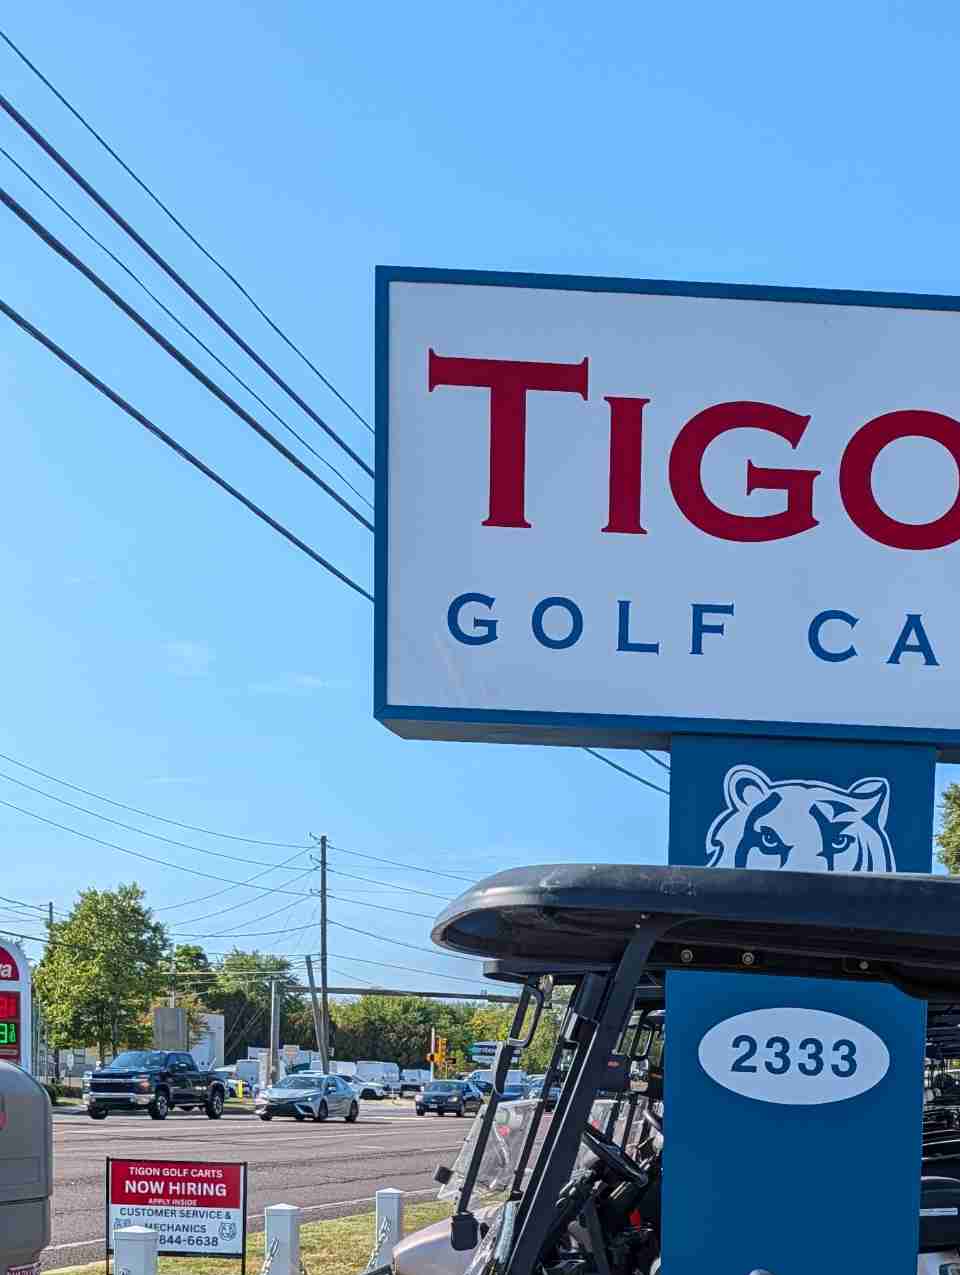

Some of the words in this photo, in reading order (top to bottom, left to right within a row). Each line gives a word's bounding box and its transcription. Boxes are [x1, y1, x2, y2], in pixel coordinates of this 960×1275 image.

[447, 592, 735, 656] GOLF
[731, 1035, 857, 1078] 2333
[128, 1166, 160, 1176] TIGON
[162, 1168, 189, 1177] GOLF
[190, 1169, 223, 1178] CARTS
[124, 1180, 164, 1194] NOW
[168, 1183, 227, 1197] HIRING
[148, 1198, 170, 1206] APPLY
[119, 1207, 180, 1218] CUSTOMER
[181, 1209, 224, 1220] SERVICE
[225, 1211, 232, 1220] &
[144, 1222, 207, 1234] MECHANICS
[159, 1235, 218, 1247] 844-6638
